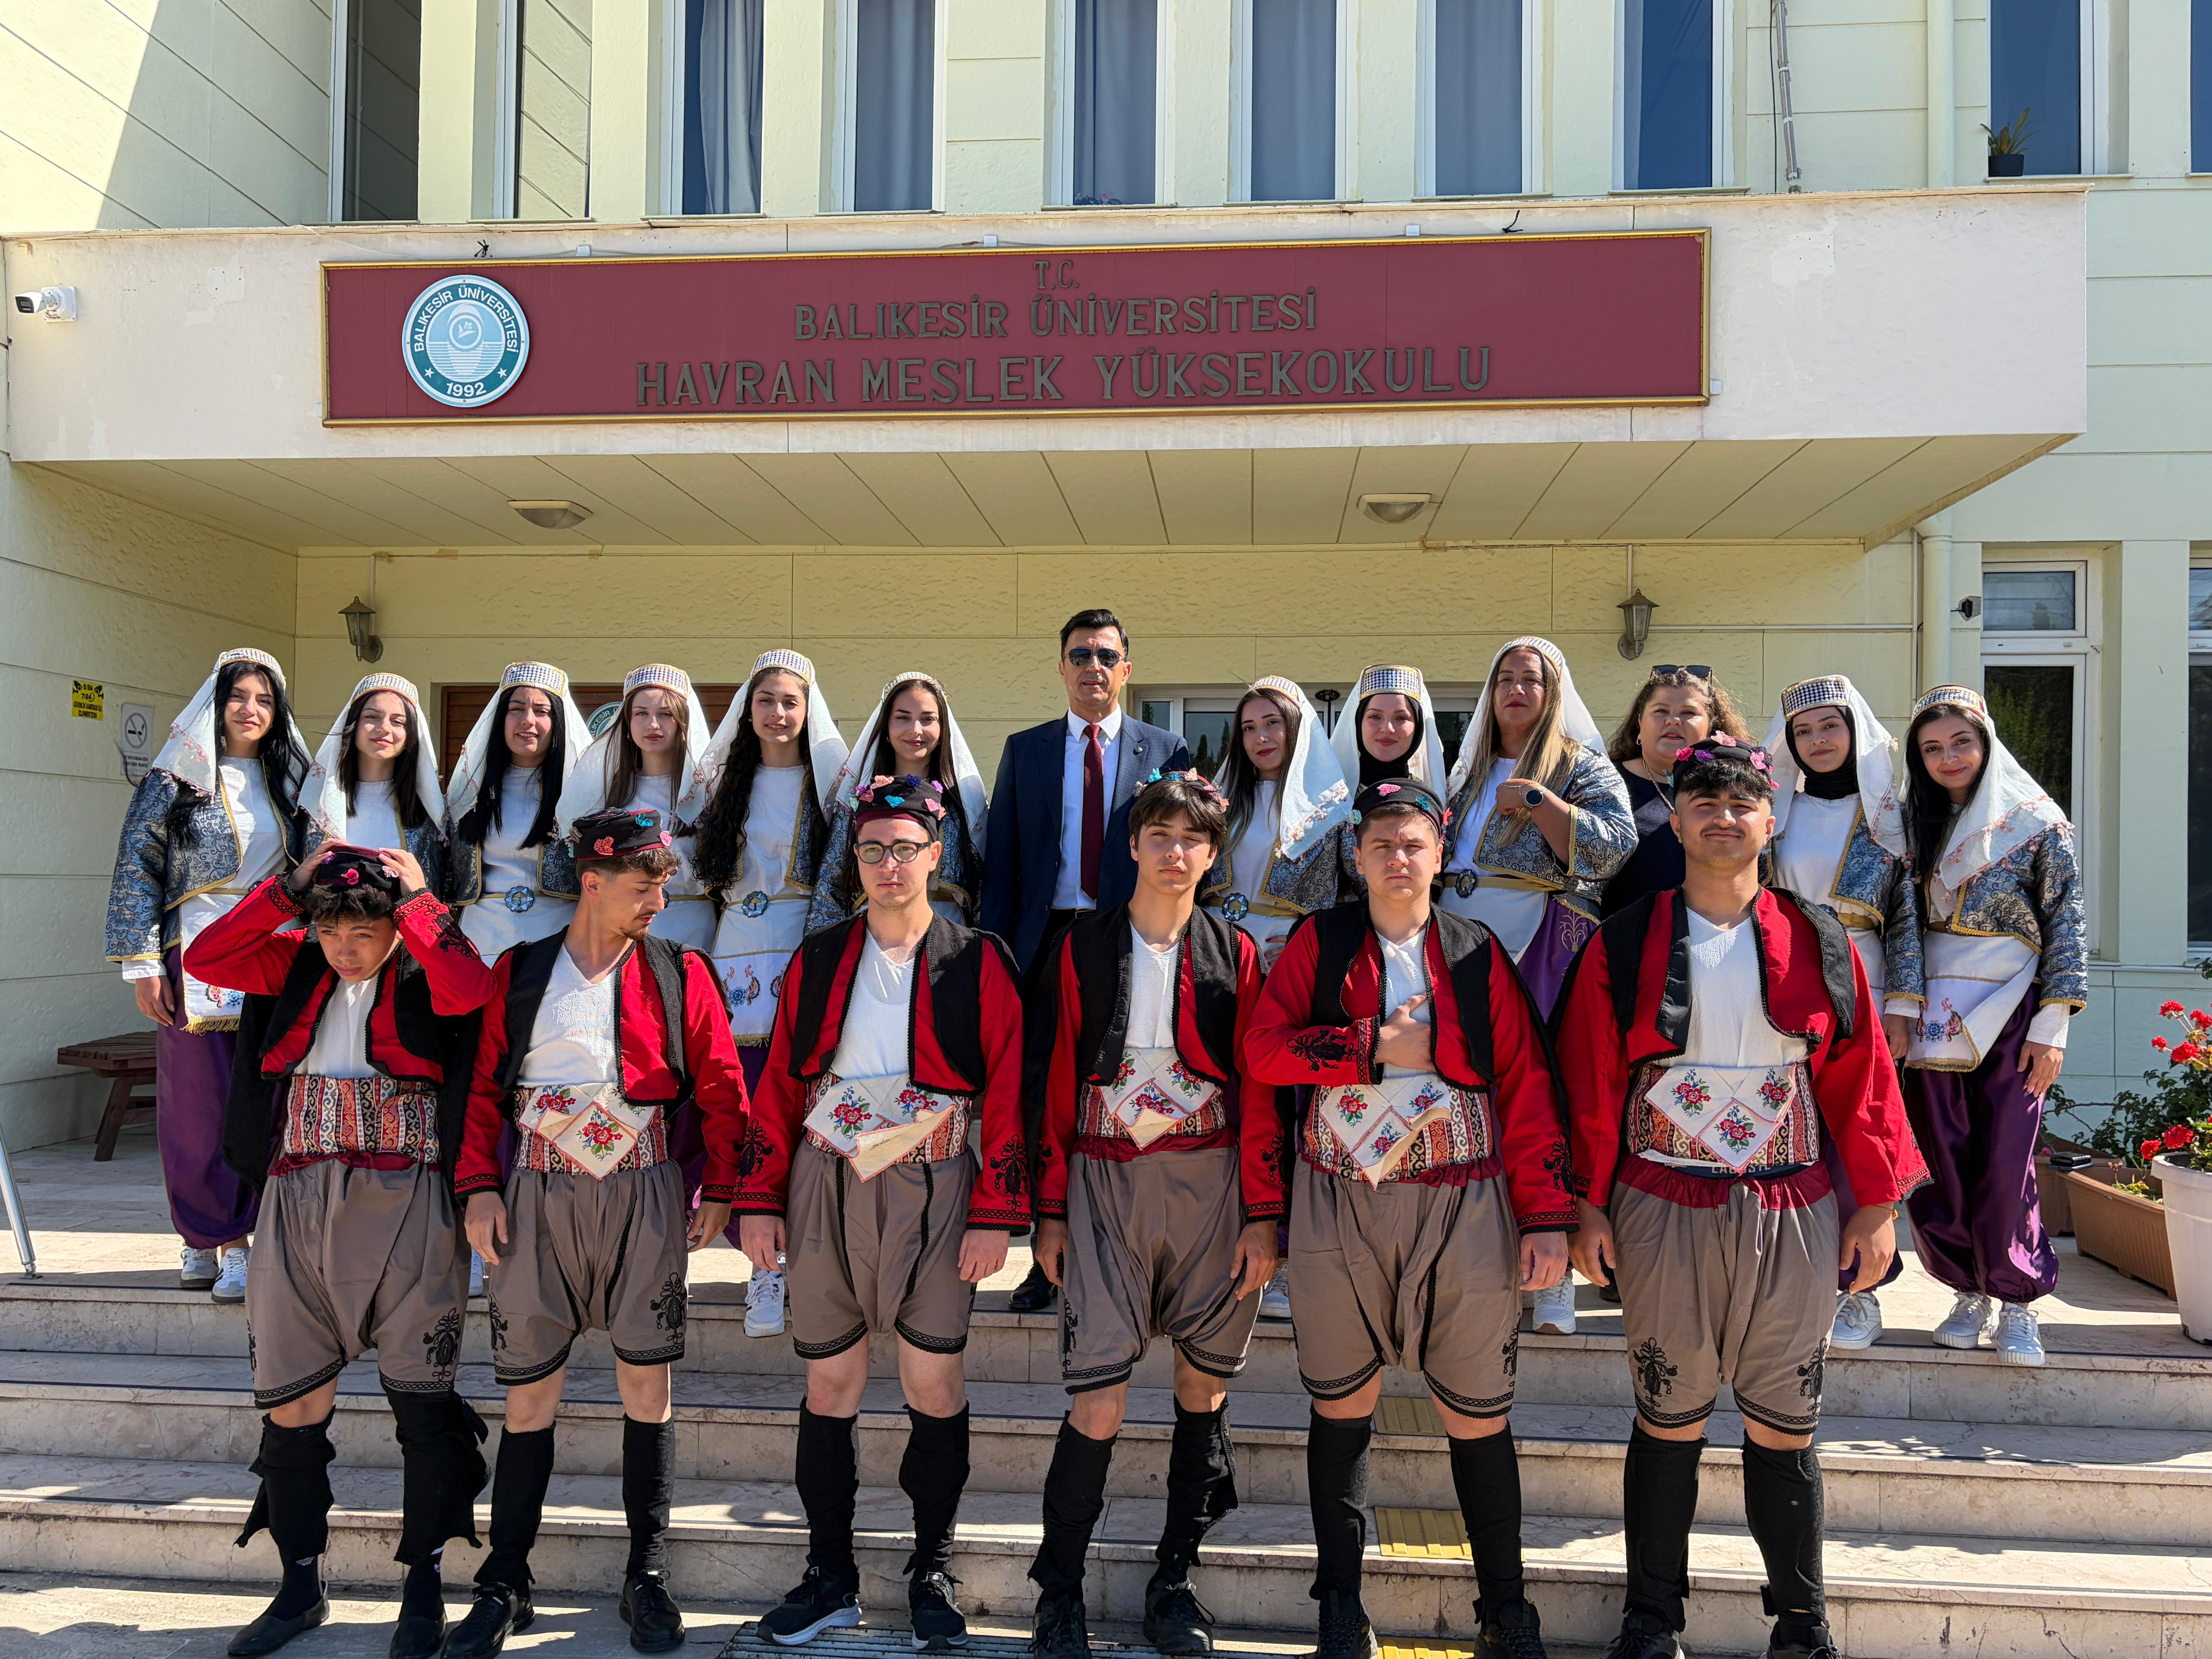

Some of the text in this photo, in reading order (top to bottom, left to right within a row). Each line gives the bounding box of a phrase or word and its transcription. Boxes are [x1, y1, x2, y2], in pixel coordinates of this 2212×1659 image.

[1033, 260, 1079, 289] T.C.
[414, 285, 519, 353] BALIKESİR ÜNİVERSİTESİ
[795, 286, 1316, 340] BALIKESİR ÜNİVERSİTESİ
[446, 382, 487, 397] 1992
[636, 347, 1491, 406] HAVRAN MESLEK YÜKSEKOKULU
[590, 710, 610, 735] LIKESİR
